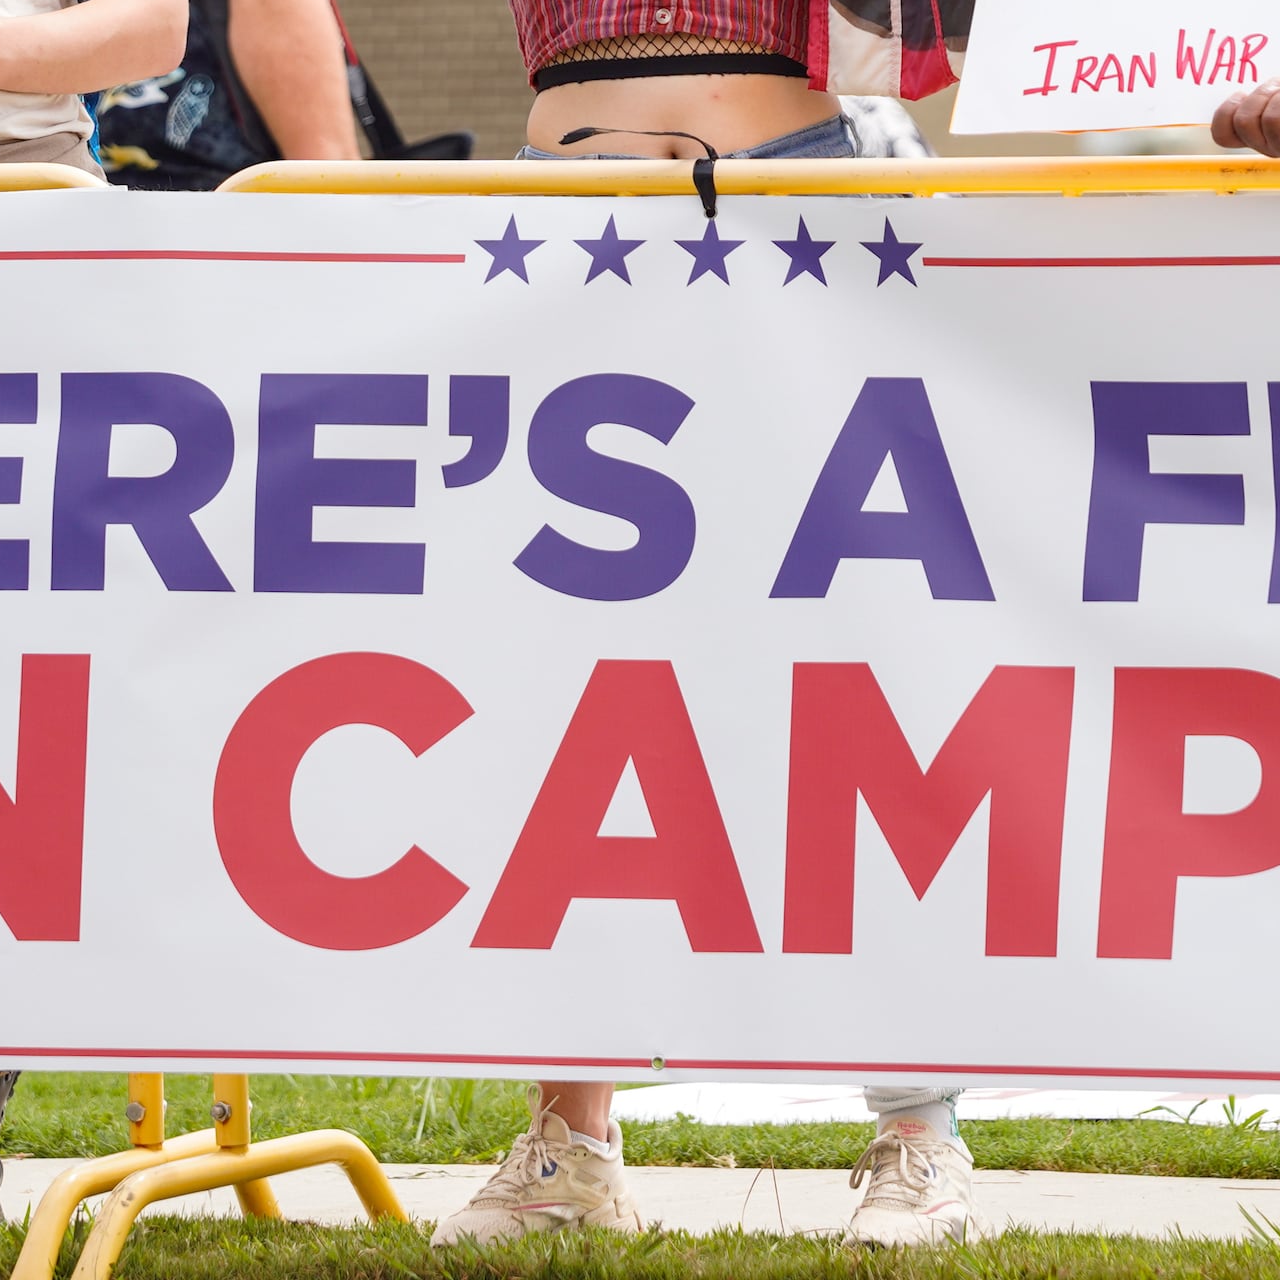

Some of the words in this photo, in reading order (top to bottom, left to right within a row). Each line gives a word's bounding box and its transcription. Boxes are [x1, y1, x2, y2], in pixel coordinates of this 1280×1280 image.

[1023, 39, 1157, 96] IRAN
[1176, 29, 1268, 85] WAR
[768, 377, 996, 602] A
